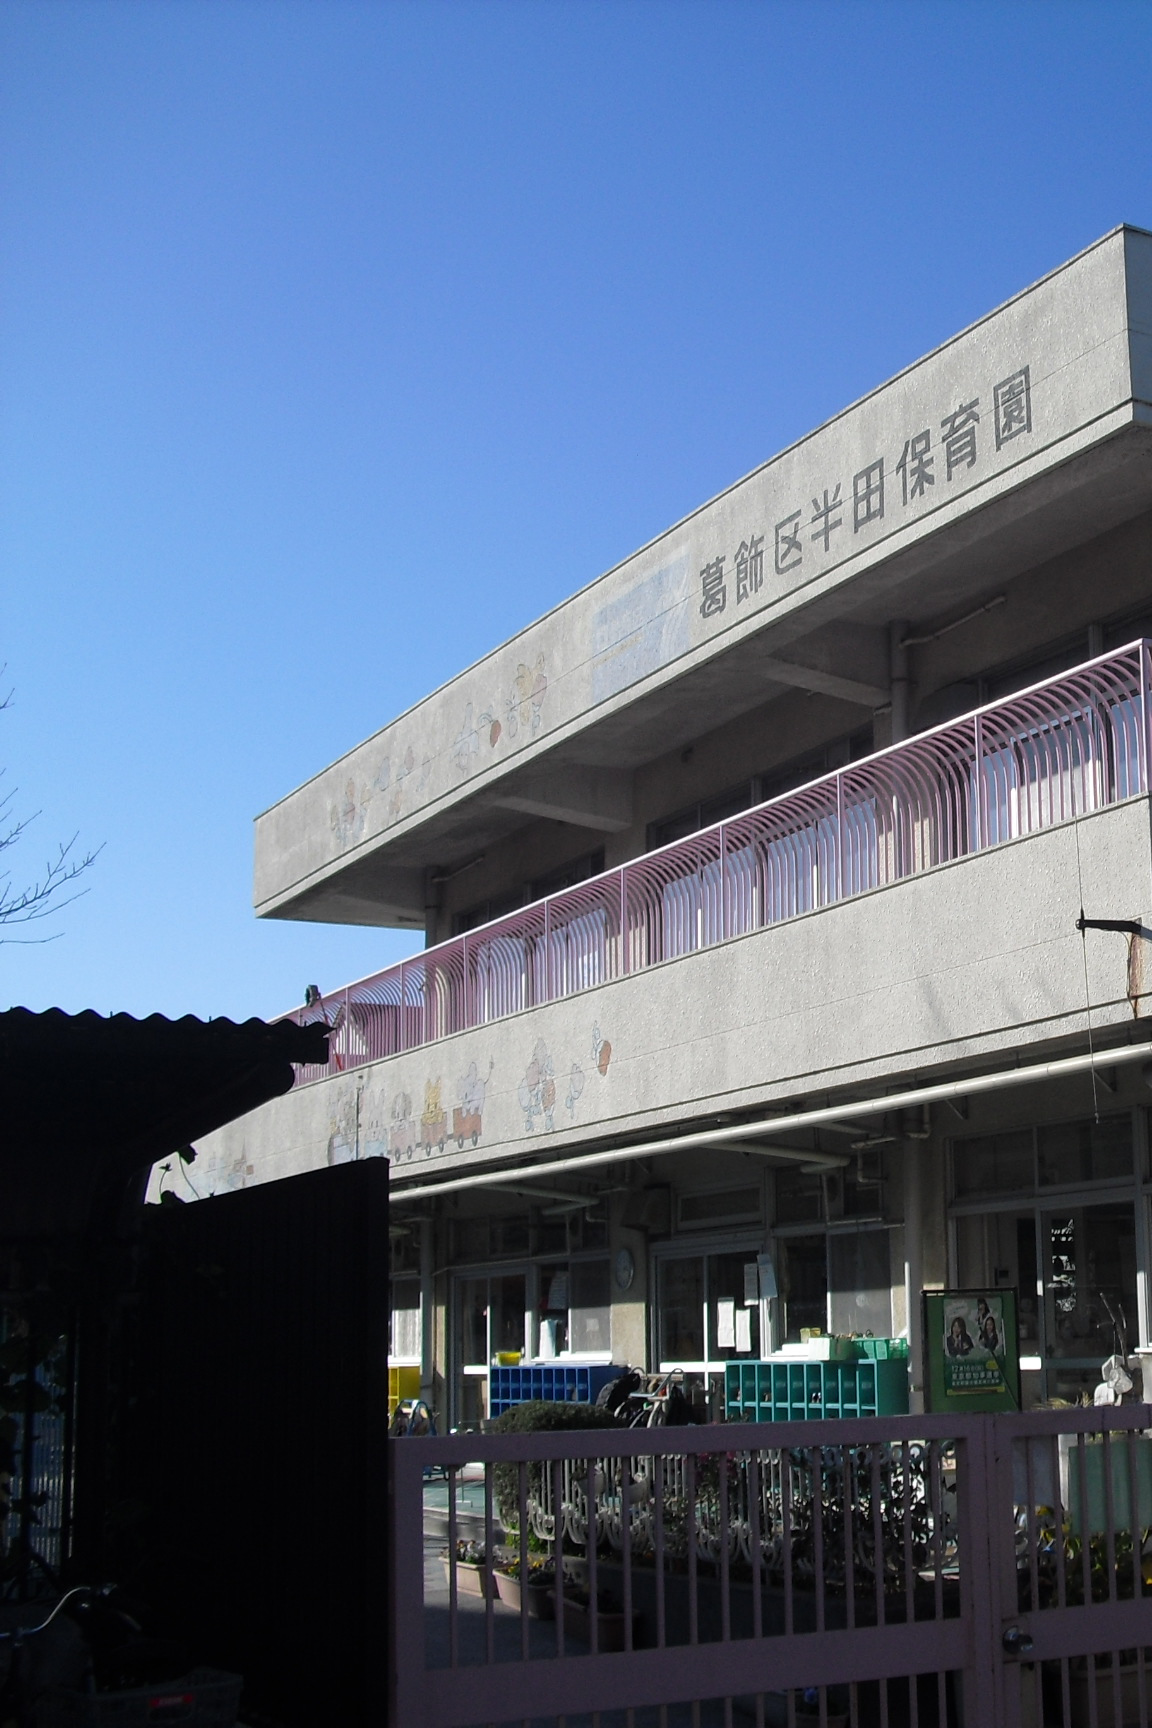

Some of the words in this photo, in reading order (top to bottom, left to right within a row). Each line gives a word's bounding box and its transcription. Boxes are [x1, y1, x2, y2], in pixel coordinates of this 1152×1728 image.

[699, 364, 1032, 619] 葛飾区半田保育園
